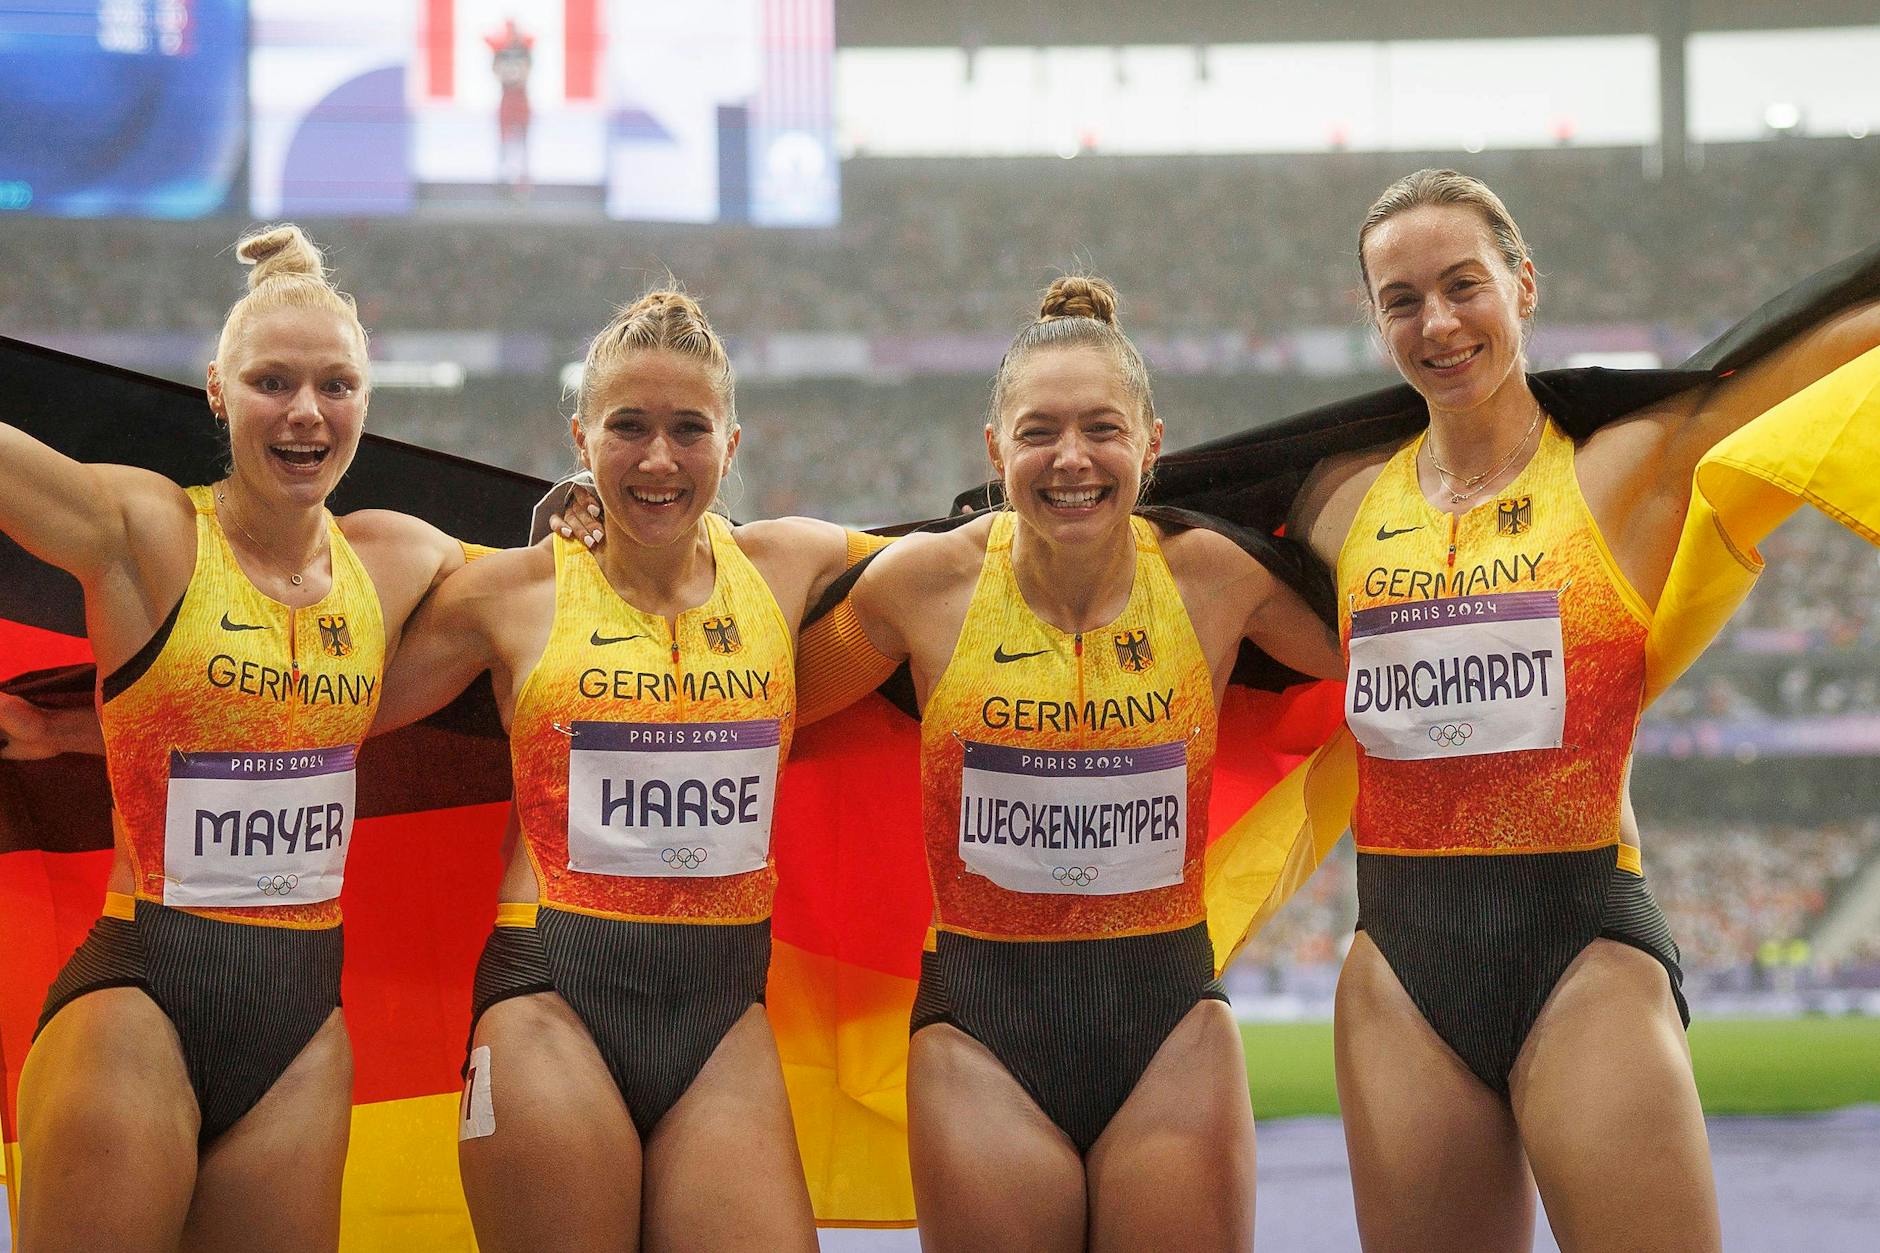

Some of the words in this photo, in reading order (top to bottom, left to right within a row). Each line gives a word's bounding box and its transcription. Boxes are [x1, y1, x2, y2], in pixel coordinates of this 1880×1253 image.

[1365, 552, 1544, 600] GERMANY
[1447, 601, 1497, 618] 2024
[207, 654, 376, 706] GERMANY
[579, 668, 770, 702] GERMANY
[1353, 650, 1553, 714] BURGHARDT
[982, 688, 1174, 733] GERMANY
[693, 729, 738, 744] 2024
[290, 755, 324, 771] 2024
[1085, 755, 1133, 770] 2024
[601, 775, 760, 827] HAASE
[963, 794, 1179, 849] LUECKENKEMPER
[194, 802, 344, 856] MAYER
